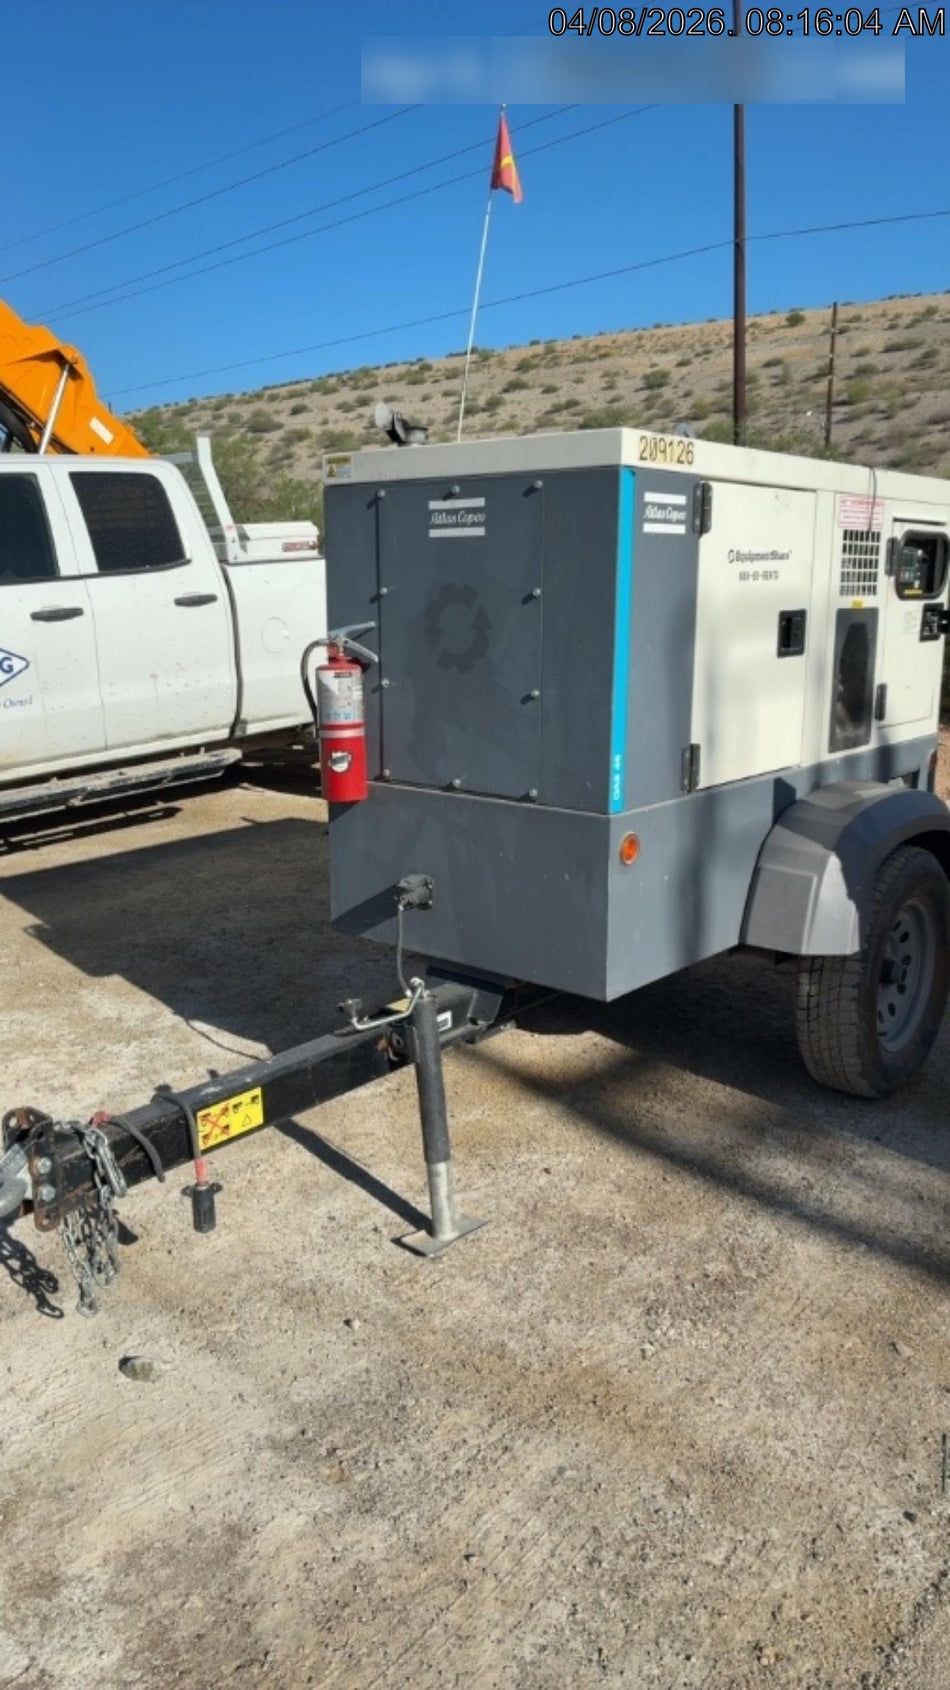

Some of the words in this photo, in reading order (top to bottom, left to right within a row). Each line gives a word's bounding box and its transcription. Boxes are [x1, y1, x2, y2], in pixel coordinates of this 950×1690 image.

[639, 435, 695, 465] 209126
[429, 511, 457, 525] Atlas
[457, 510, 486, 525] Copco
[643, 504, 666, 520] Atlas
